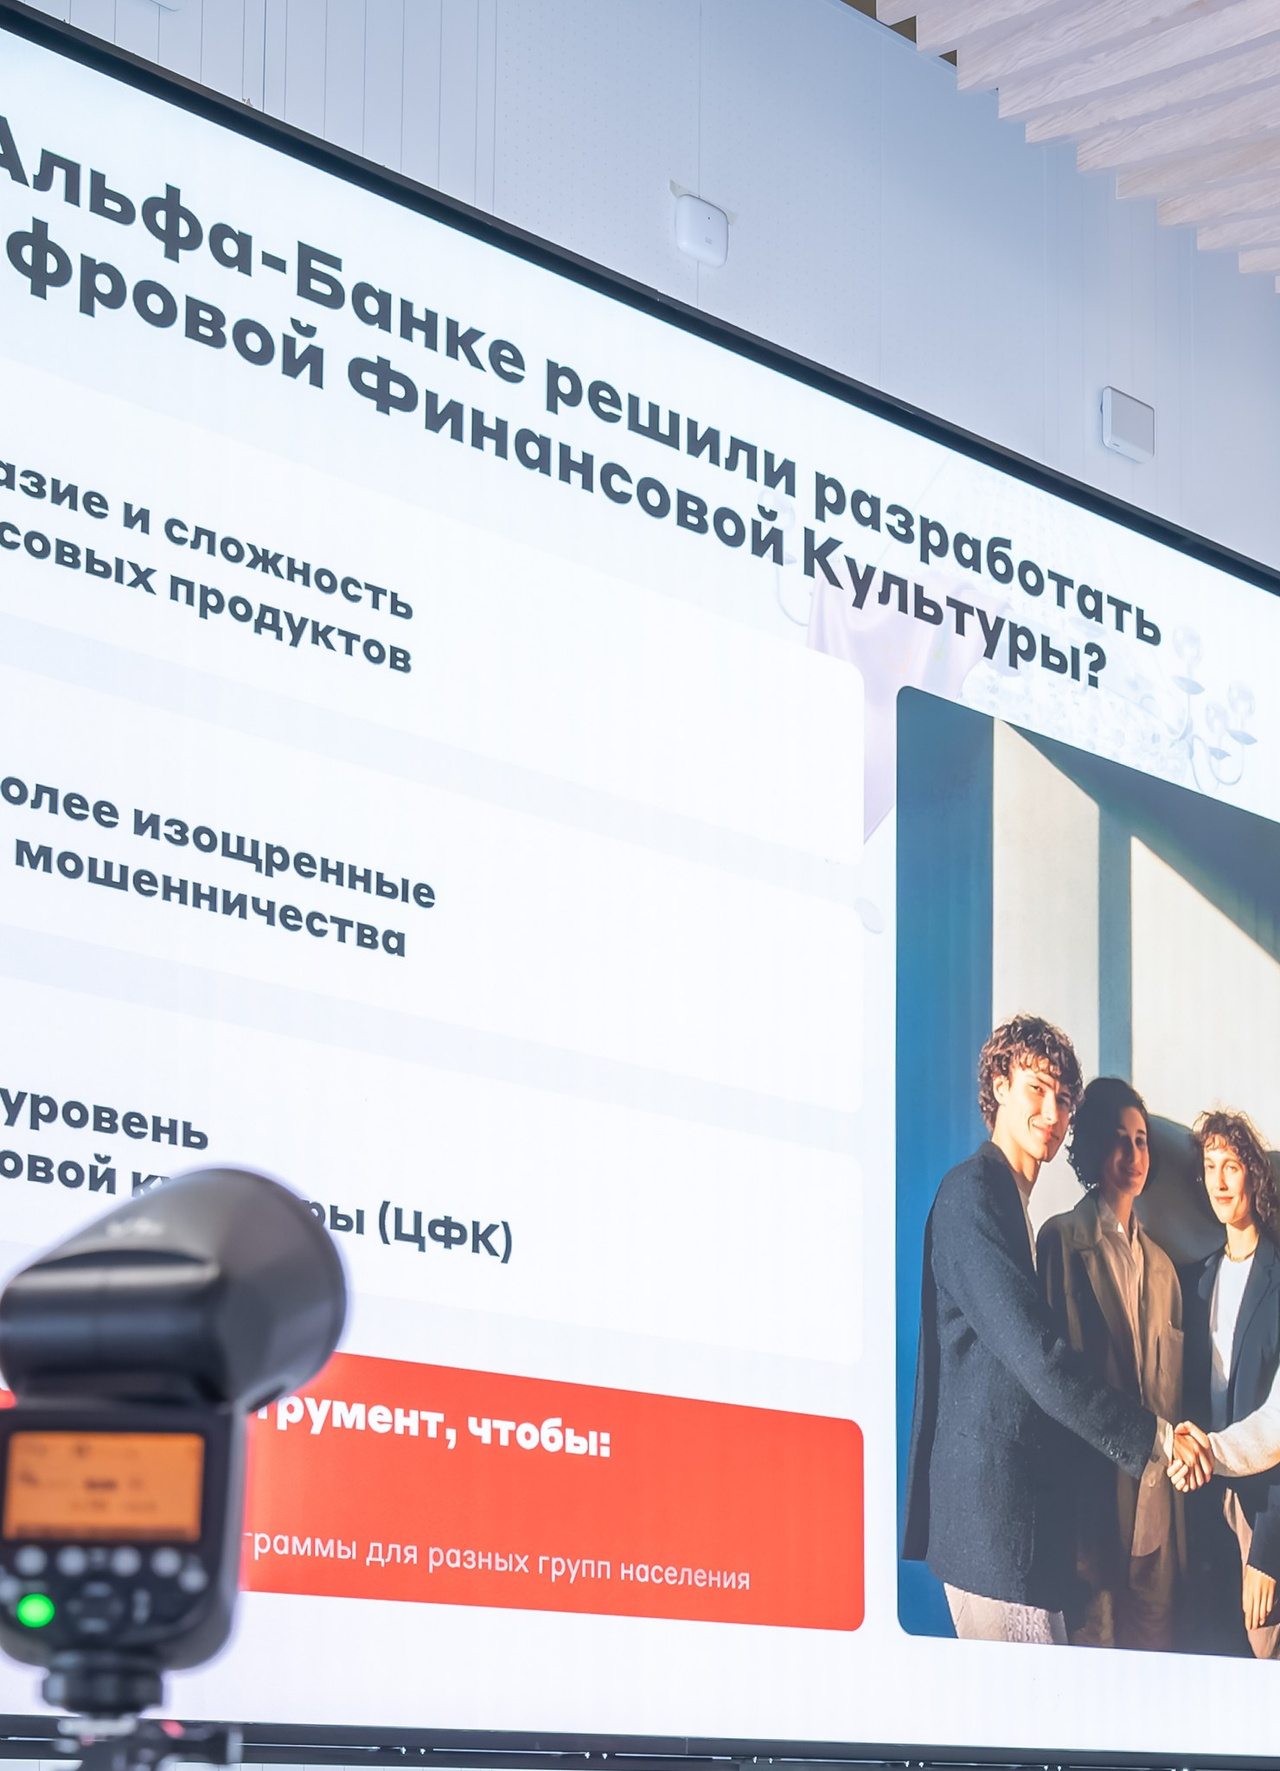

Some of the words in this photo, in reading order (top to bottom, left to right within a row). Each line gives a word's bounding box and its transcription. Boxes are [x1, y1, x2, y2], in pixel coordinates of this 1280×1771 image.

[347, 355, 784, 567] Финансовой
[803, 526, 1107, 689] Культуры?
[546, 358, 796, 499] решили
[814, 471, 1162, 647] разработать
[123, 501, 150, 536] и
[164, 517, 413, 620] сложность
[169, 574, 412, 674] продуктов
[15, 838, 406, 958] мошенничества
[133, 808, 436, 909] изощренные
[0, 1087, 208, 1150] уровень
[378, 1200, 513, 1264] (ЦФК)
[468, 1416, 611, 1458] чтобы:
[244, 1532, 357, 1561] раммы
[365, 1541, 418, 1568] для
[428, 1546, 530, 1574] разных
[538, 1555, 611, 1584] групп
[620, 1562, 751, 1591] населения
